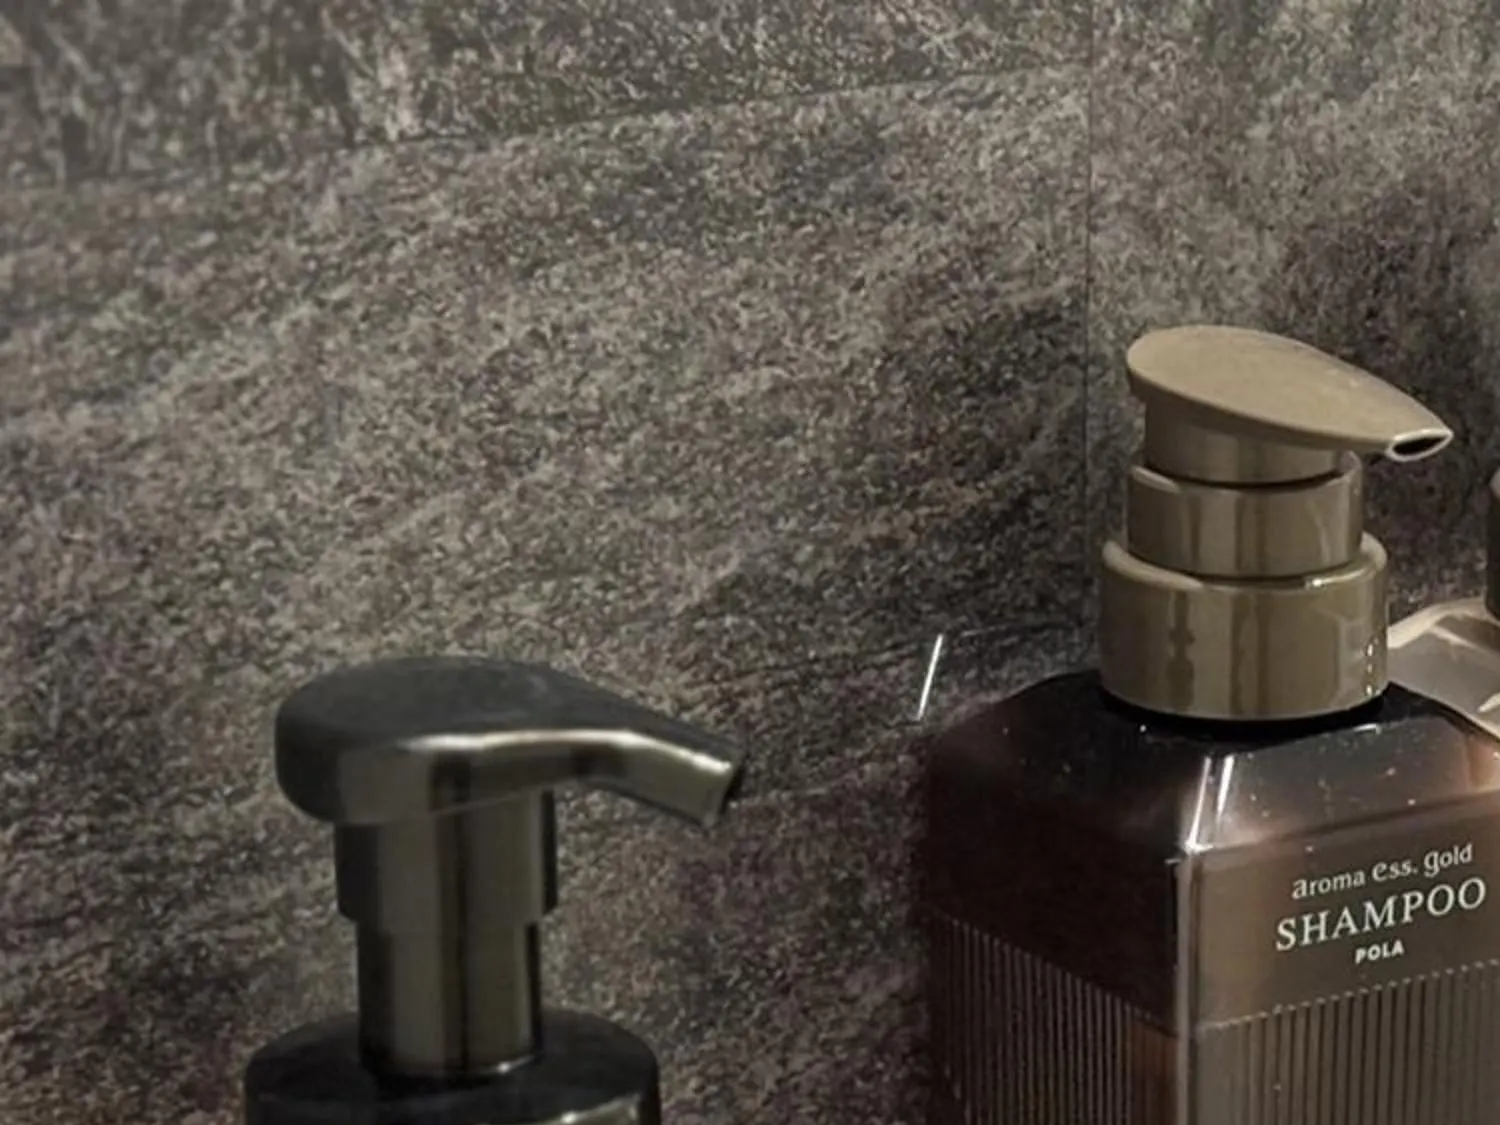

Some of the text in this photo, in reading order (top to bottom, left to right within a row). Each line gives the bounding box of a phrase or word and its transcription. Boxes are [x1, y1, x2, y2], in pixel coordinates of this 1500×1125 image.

[1292, 843, 1473, 900] aroma ess. gold
[1275, 877, 1487, 951] SHAMPOO
[1354, 940, 1405, 964] POLA
